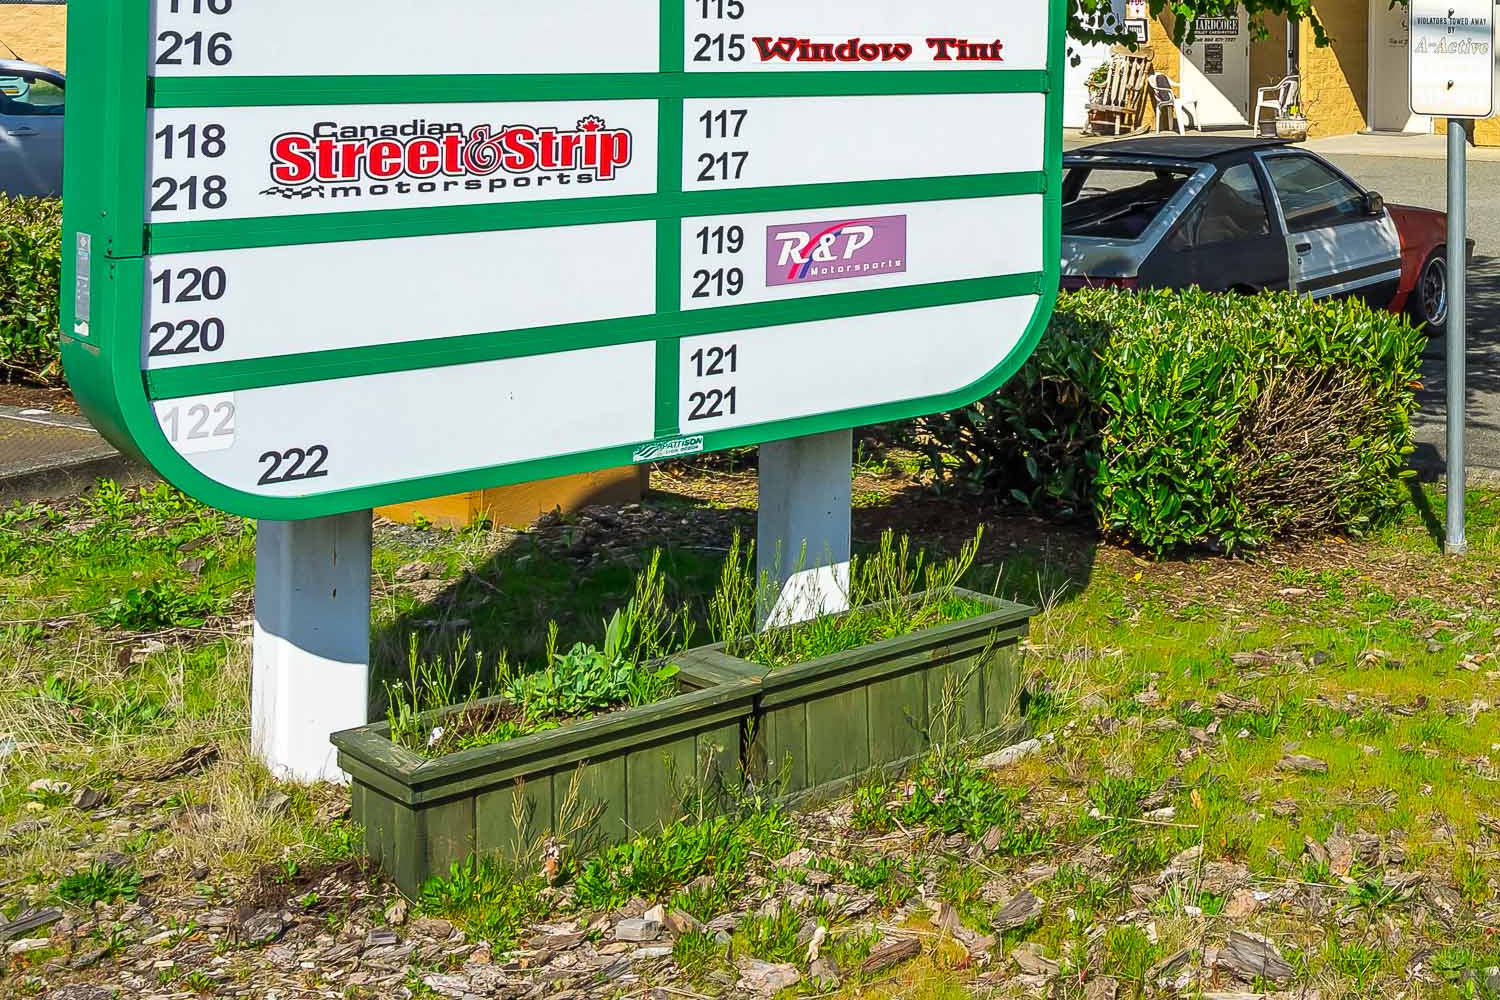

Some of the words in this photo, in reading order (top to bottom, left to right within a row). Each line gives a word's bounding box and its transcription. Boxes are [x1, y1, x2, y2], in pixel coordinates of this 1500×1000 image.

[153, 27, 232, 68] 216
[693, 33, 745, 61] 215
[752, 36, 913, 62] Window
[926, 37, 1004, 62] Tint
[151, 121, 225, 162] 118
[313, 119, 463, 138] Canadian
[700, 110, 747, 138] 117
[331, 171, 593, 198] motorsports
[697, 152, 748, 181] 217
[148, 173, 227, 213] 218
[697, 226, 743, 254] 119
[150, 266, 226, 303] 120
[692, 268, 743, 298] 219
[810, 259, 902, 276] Motorsports
[147, 315, 224, 358] 220
[691, 344, 736, 377] 121
[161, 399, 236, 442] 122
[688, 386, 736, 421] 221
[257, 445, 328, 485] 222
